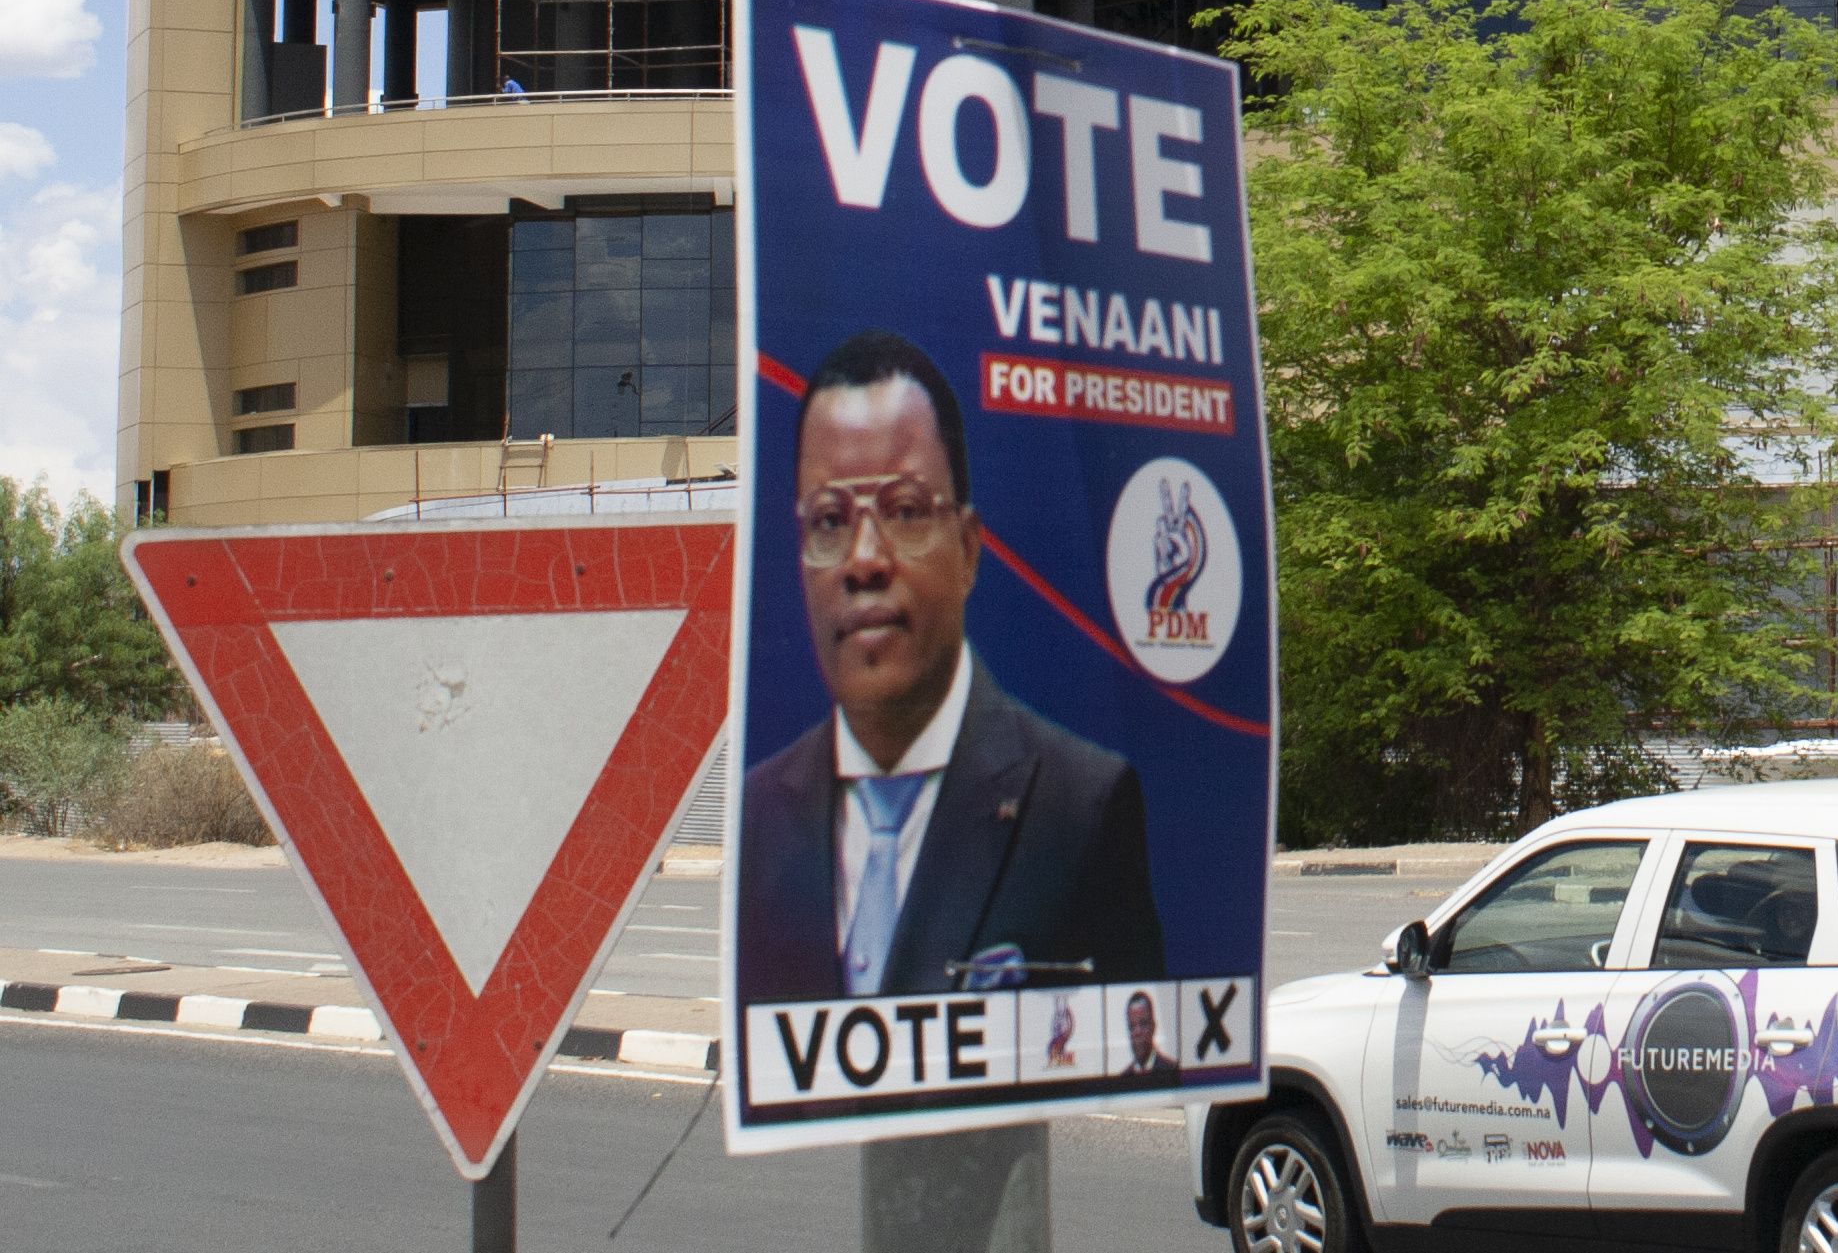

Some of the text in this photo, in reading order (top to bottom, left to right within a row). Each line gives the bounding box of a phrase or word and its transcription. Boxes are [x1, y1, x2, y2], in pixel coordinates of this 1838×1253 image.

[792, 25, 1212, 263] VOTE
[986, 274, 1224, 365] VENAANI
[989, 362, 1230, 424] FOR PRESIDENT
[1147, 609, 1208, 640] PDM
[774, 1001, 988, 1091] VOTE
[1618, 1048, 1776, 1071] FUTUREMEDIA
[1396, 1095, 1550, 1119] sales@futuremedia.com.na
[1527, 1141, 1566, 1160] NOVA
